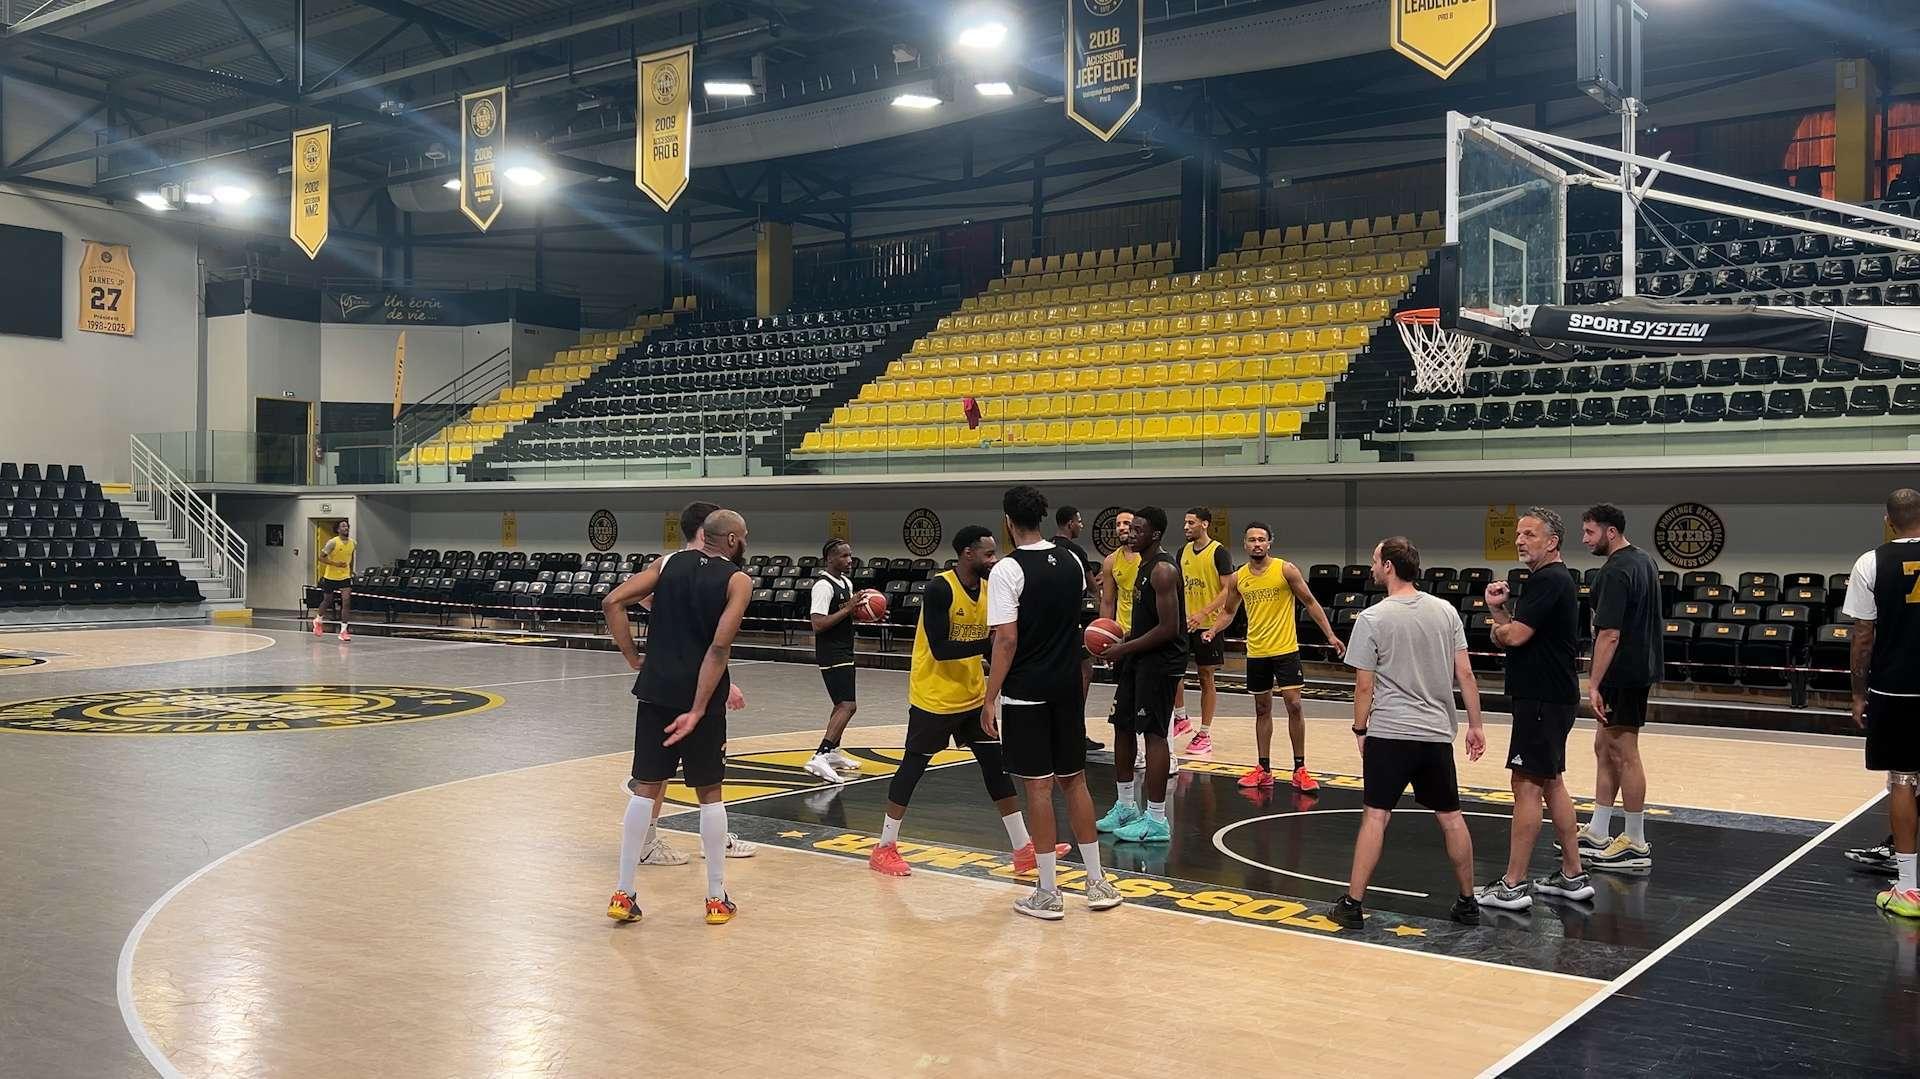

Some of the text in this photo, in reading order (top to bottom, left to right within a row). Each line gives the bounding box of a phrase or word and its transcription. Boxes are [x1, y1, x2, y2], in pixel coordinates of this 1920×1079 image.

[1089, 27, 1120, 49] 2018
[1086, 49, 1124, 67] ACCESSION
[1076, 57, 1137, 88] JEEP ELITE
[655, 116, 676, 132] 2009
[653, 142, 679, 161] PRO B
[88, 275, 114, 285] BARNES
[91, 286, 122, 311] 27
[386, 308, 403, 320] de
[1659, 505, 1695, 530] PROVENCE
